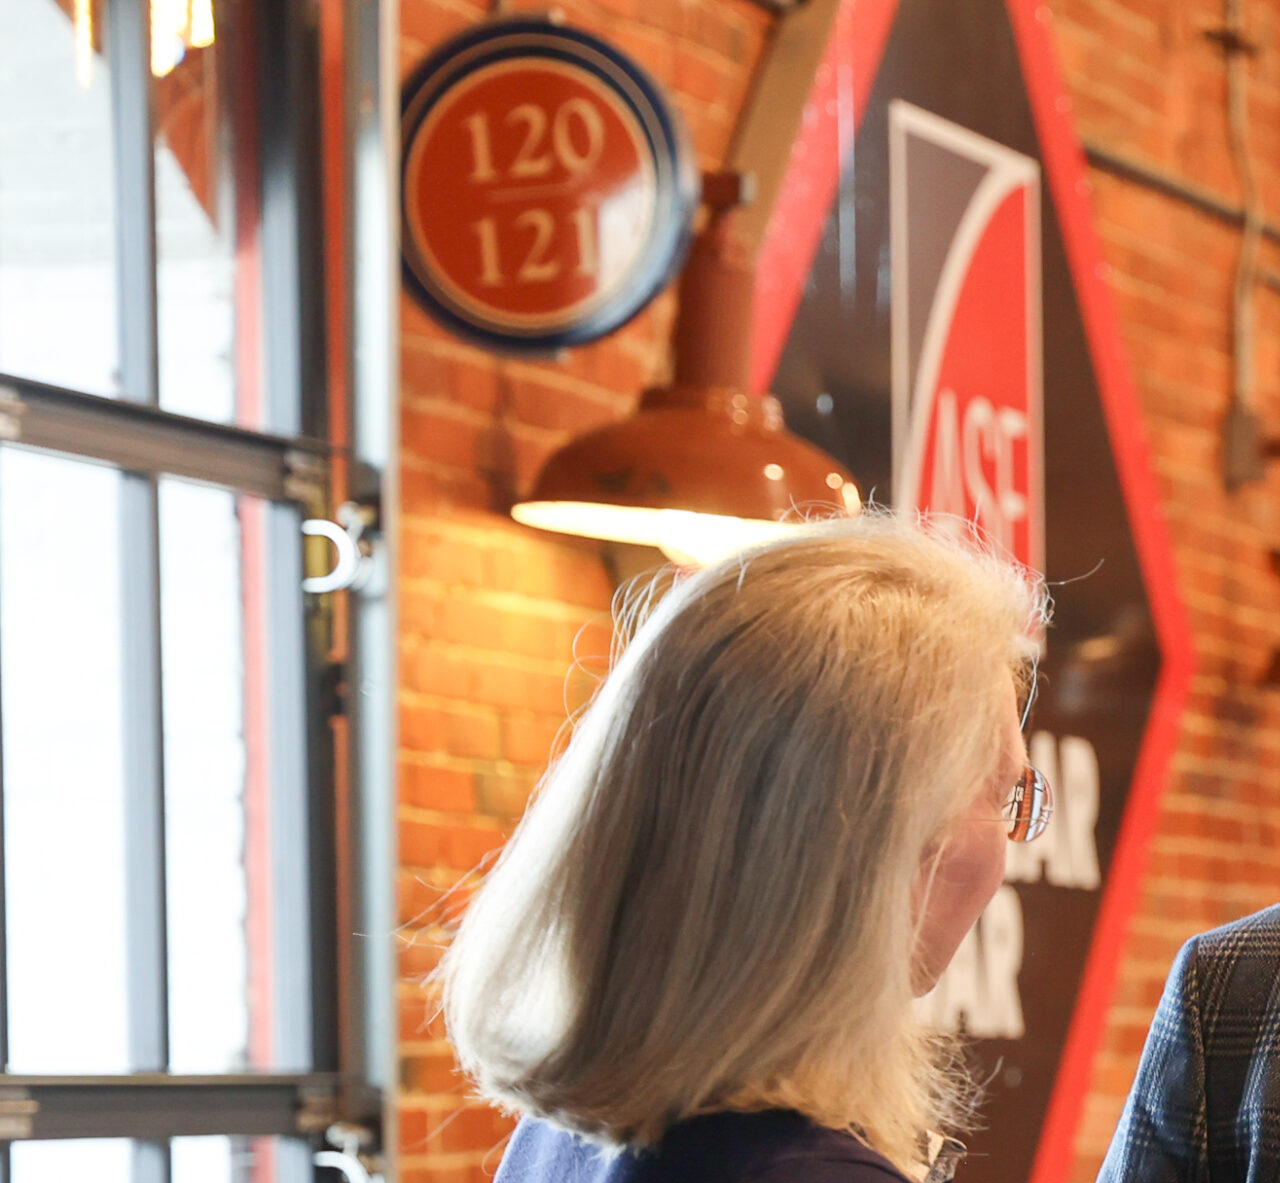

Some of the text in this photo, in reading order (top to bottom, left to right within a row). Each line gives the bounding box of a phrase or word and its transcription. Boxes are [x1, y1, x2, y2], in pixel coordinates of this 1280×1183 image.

[464, 97, 605, 183] 120
[474, 204, 599, 287] 121
[1004, 729, 1102, 891] AR
[911, 884, 1026, 1039] AR
